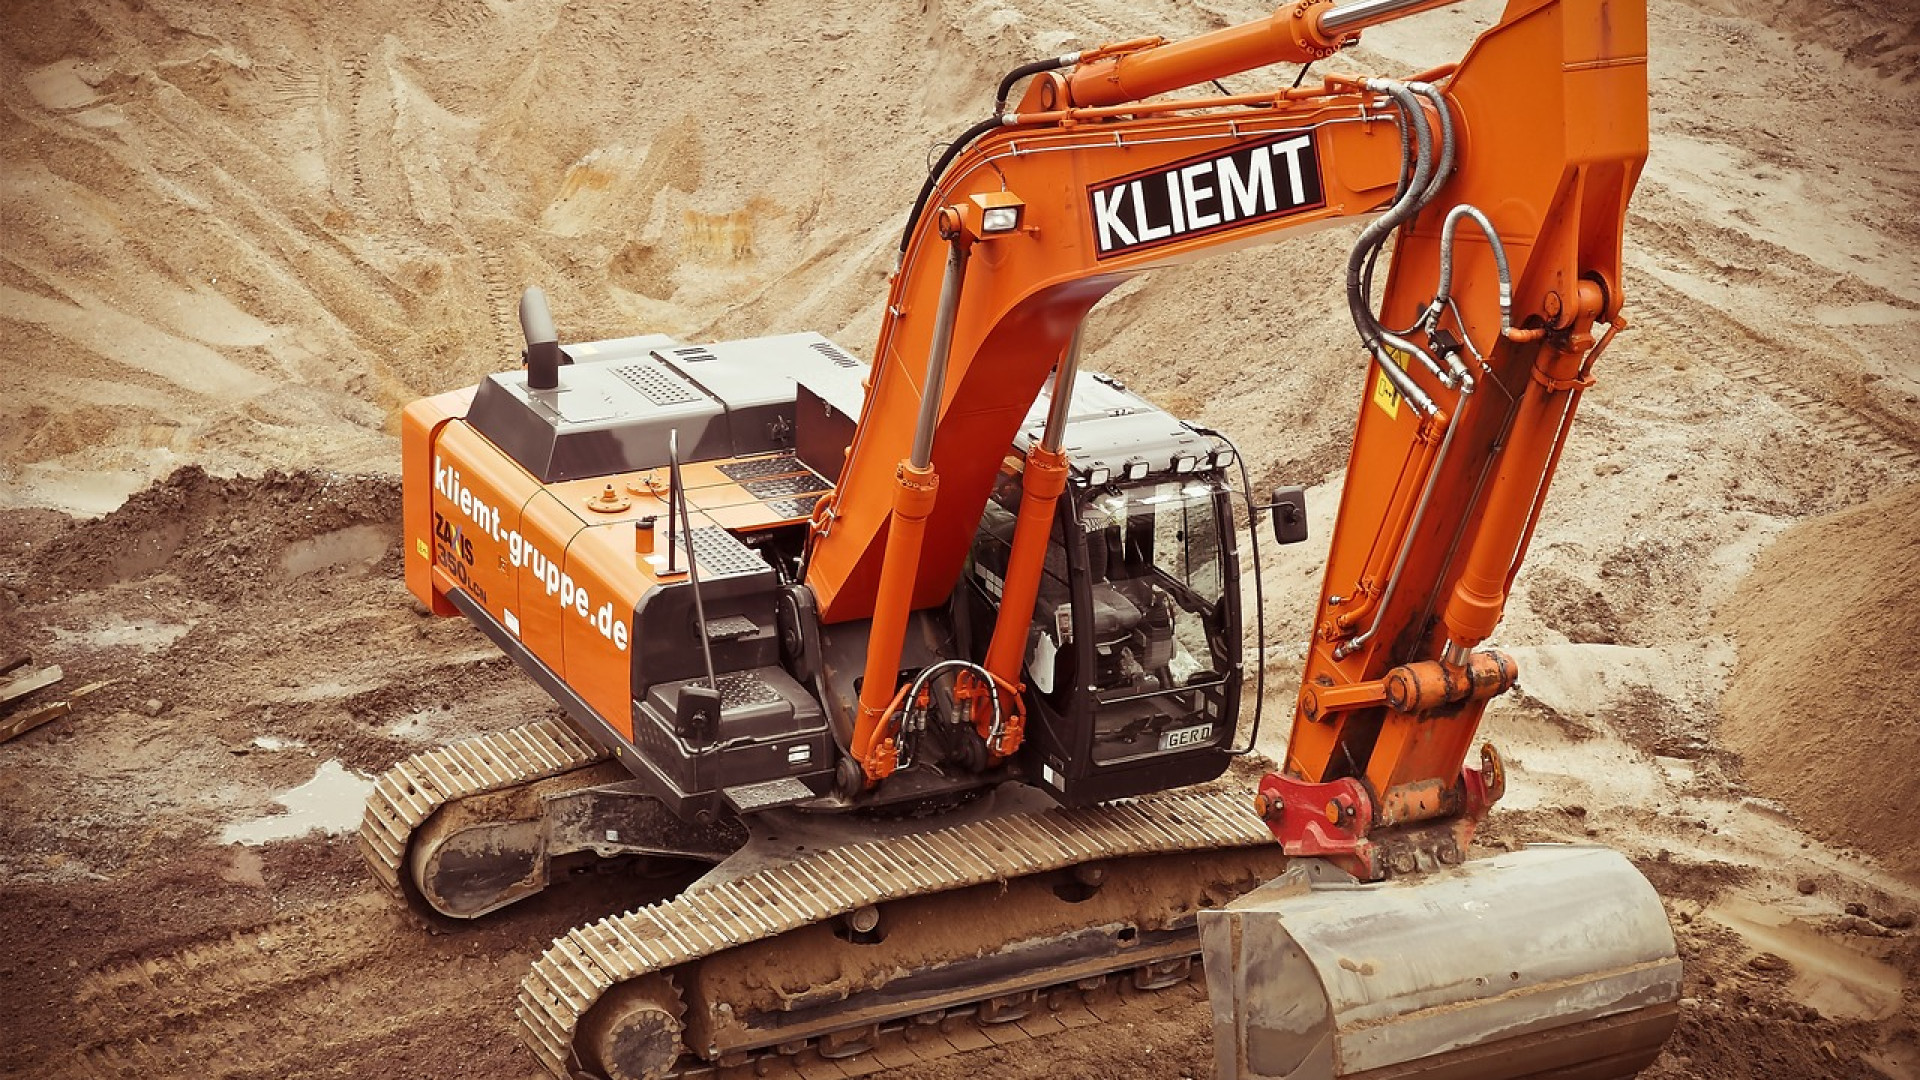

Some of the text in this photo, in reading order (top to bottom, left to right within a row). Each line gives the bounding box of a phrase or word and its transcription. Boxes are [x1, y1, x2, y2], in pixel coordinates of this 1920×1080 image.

[1093, 135, 1311, 251] KLIEMT
[434, 455, 628, 651] kliemt-gruppe.de
[435, 511, 474, 566] ZAXIS
[1169, 727, 1210, 746] GERD
